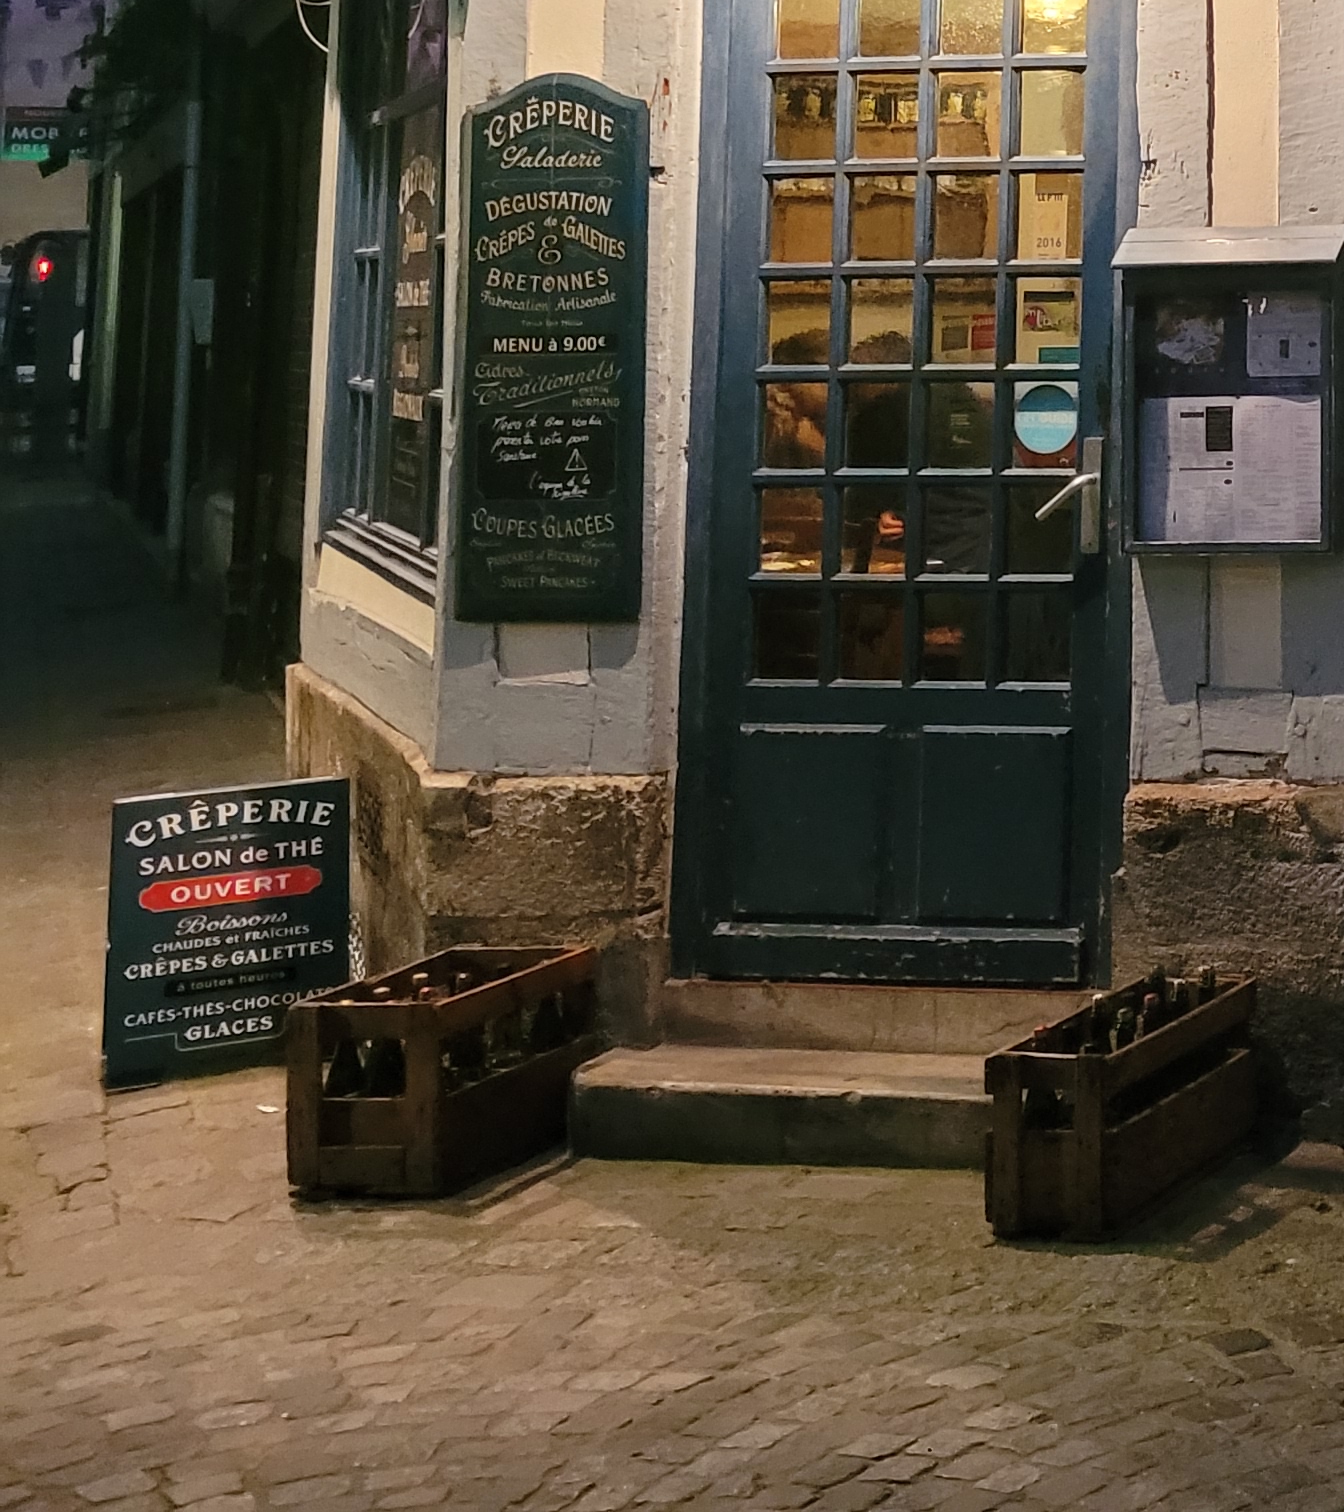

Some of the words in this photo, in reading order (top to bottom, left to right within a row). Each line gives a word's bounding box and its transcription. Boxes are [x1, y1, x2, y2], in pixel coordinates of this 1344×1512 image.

[484, 96, 615, 148] CRÊPERIE
[500, 145, 603, 170] Saladerie
[485, 191, 613, 221] DÉGUSTATION
[543, 215, 558, 227] de
[562, 215, 627, 260] GALETTES
[1036, 237, 1062, 248] 2016
[486, 268, 610, 293] BRETONNES
[481, 290, 549, 312] Fabrication
[555, 289, 617, 311] Artisanale
[493, 338, 543, 352] MENU
[548, 337, 558, 352] à
[471, 507, 538, 538] COUPES
[541, 512, 616, 538] GLACÉES
[125, 797, 336, 848] CRÊPERIE
[139, 849, 232, 876] SALON
[239, 845, 270, 864] de
[274, 836, 324, 859] THÉ
[170, 873, 292, 904] OUVERT
[175, 910, 288, 937] Boissons
[152, 935, 221, 954] CHAUDES
[225, 934, 239, 945] et
[124, 955, 208, 980] CRÊPES
[211, 953, 229, 969] &
[231, 939, 335, 966] GALETTES
[190, 975, 234, 990] toutes
[239, 971, 286, 985] heures
[183, 1015, 274, 1042] GLACES
